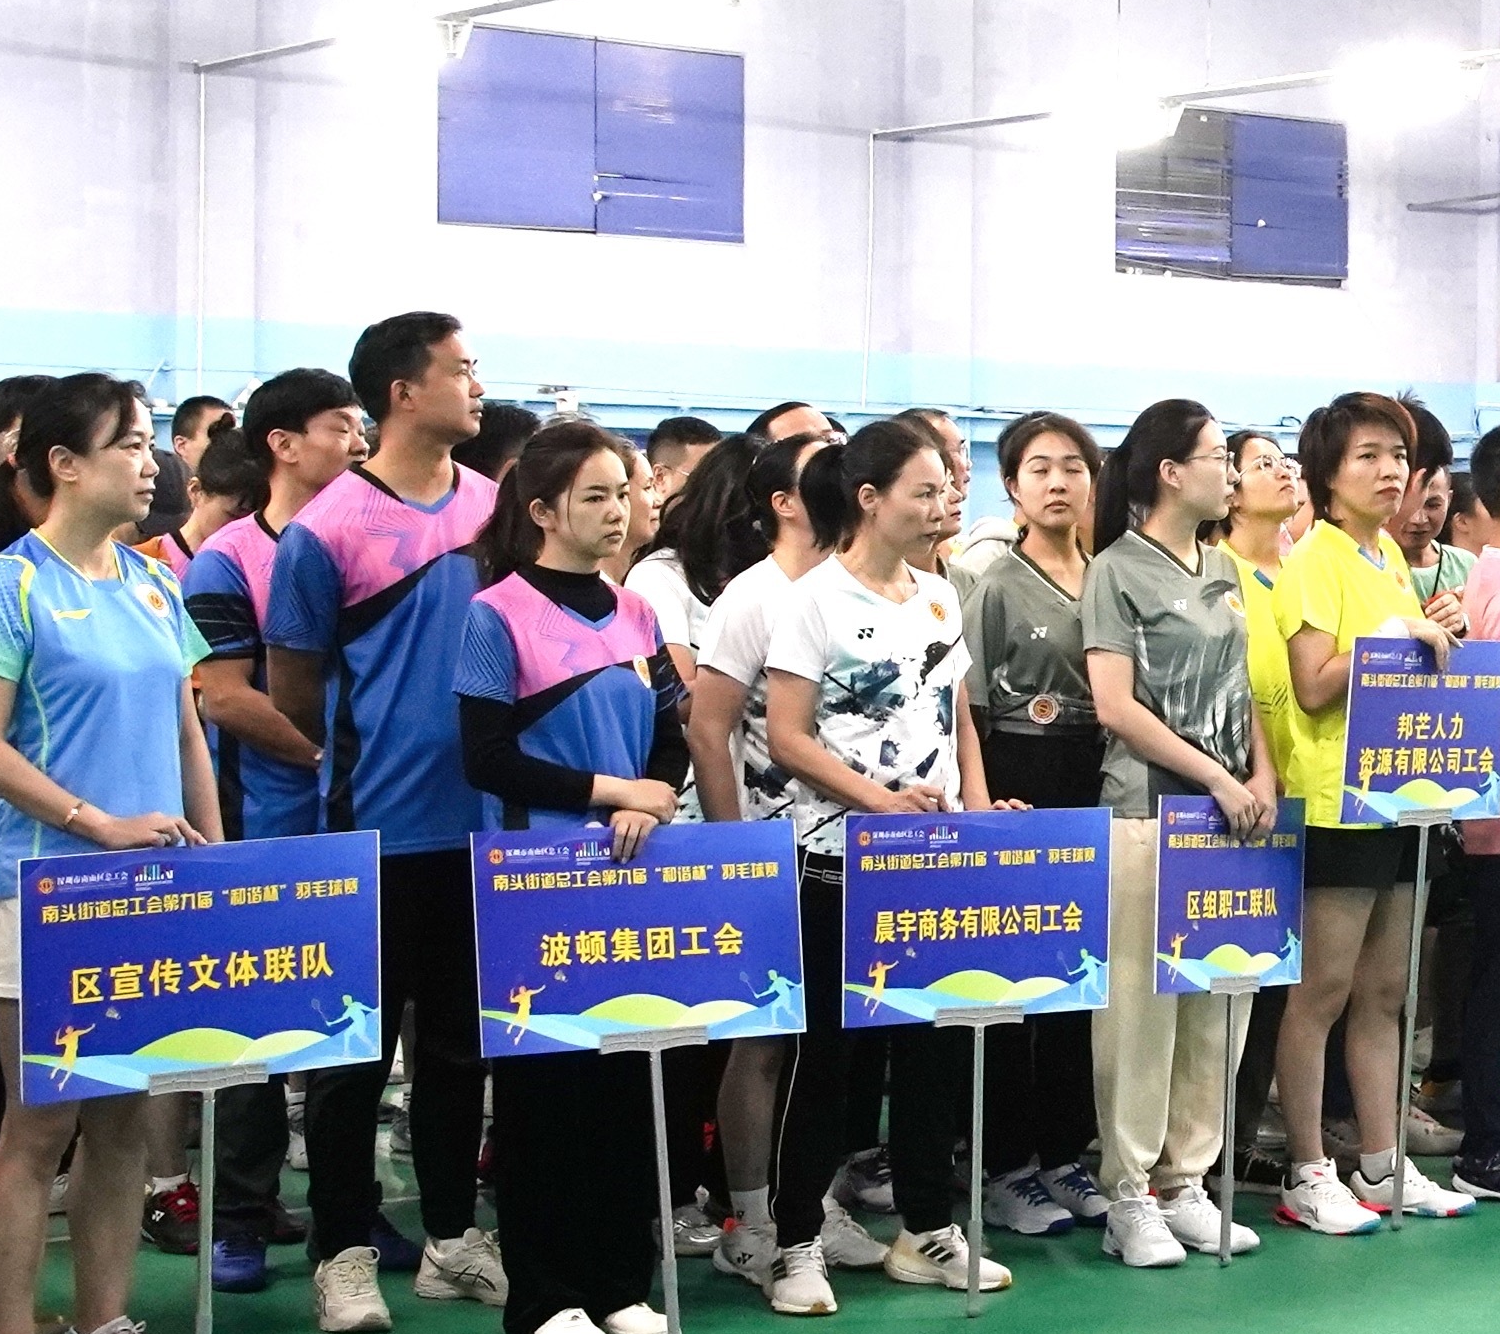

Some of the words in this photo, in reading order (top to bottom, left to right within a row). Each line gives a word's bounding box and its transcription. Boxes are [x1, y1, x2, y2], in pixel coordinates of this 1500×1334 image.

[1396, 712, 1464, 741] 邦芒人力
[1358, 746, 1495, 777] 资源有限公司工会
[1186, 887, 1278, 920] 区组职工联队
[874, 901, 1083, 945] 晨宇商务有限公司工会
[539, 922, 743, 967] 波顿集团工会
[71, 942, 334, 1005] 区宣传文体联队
